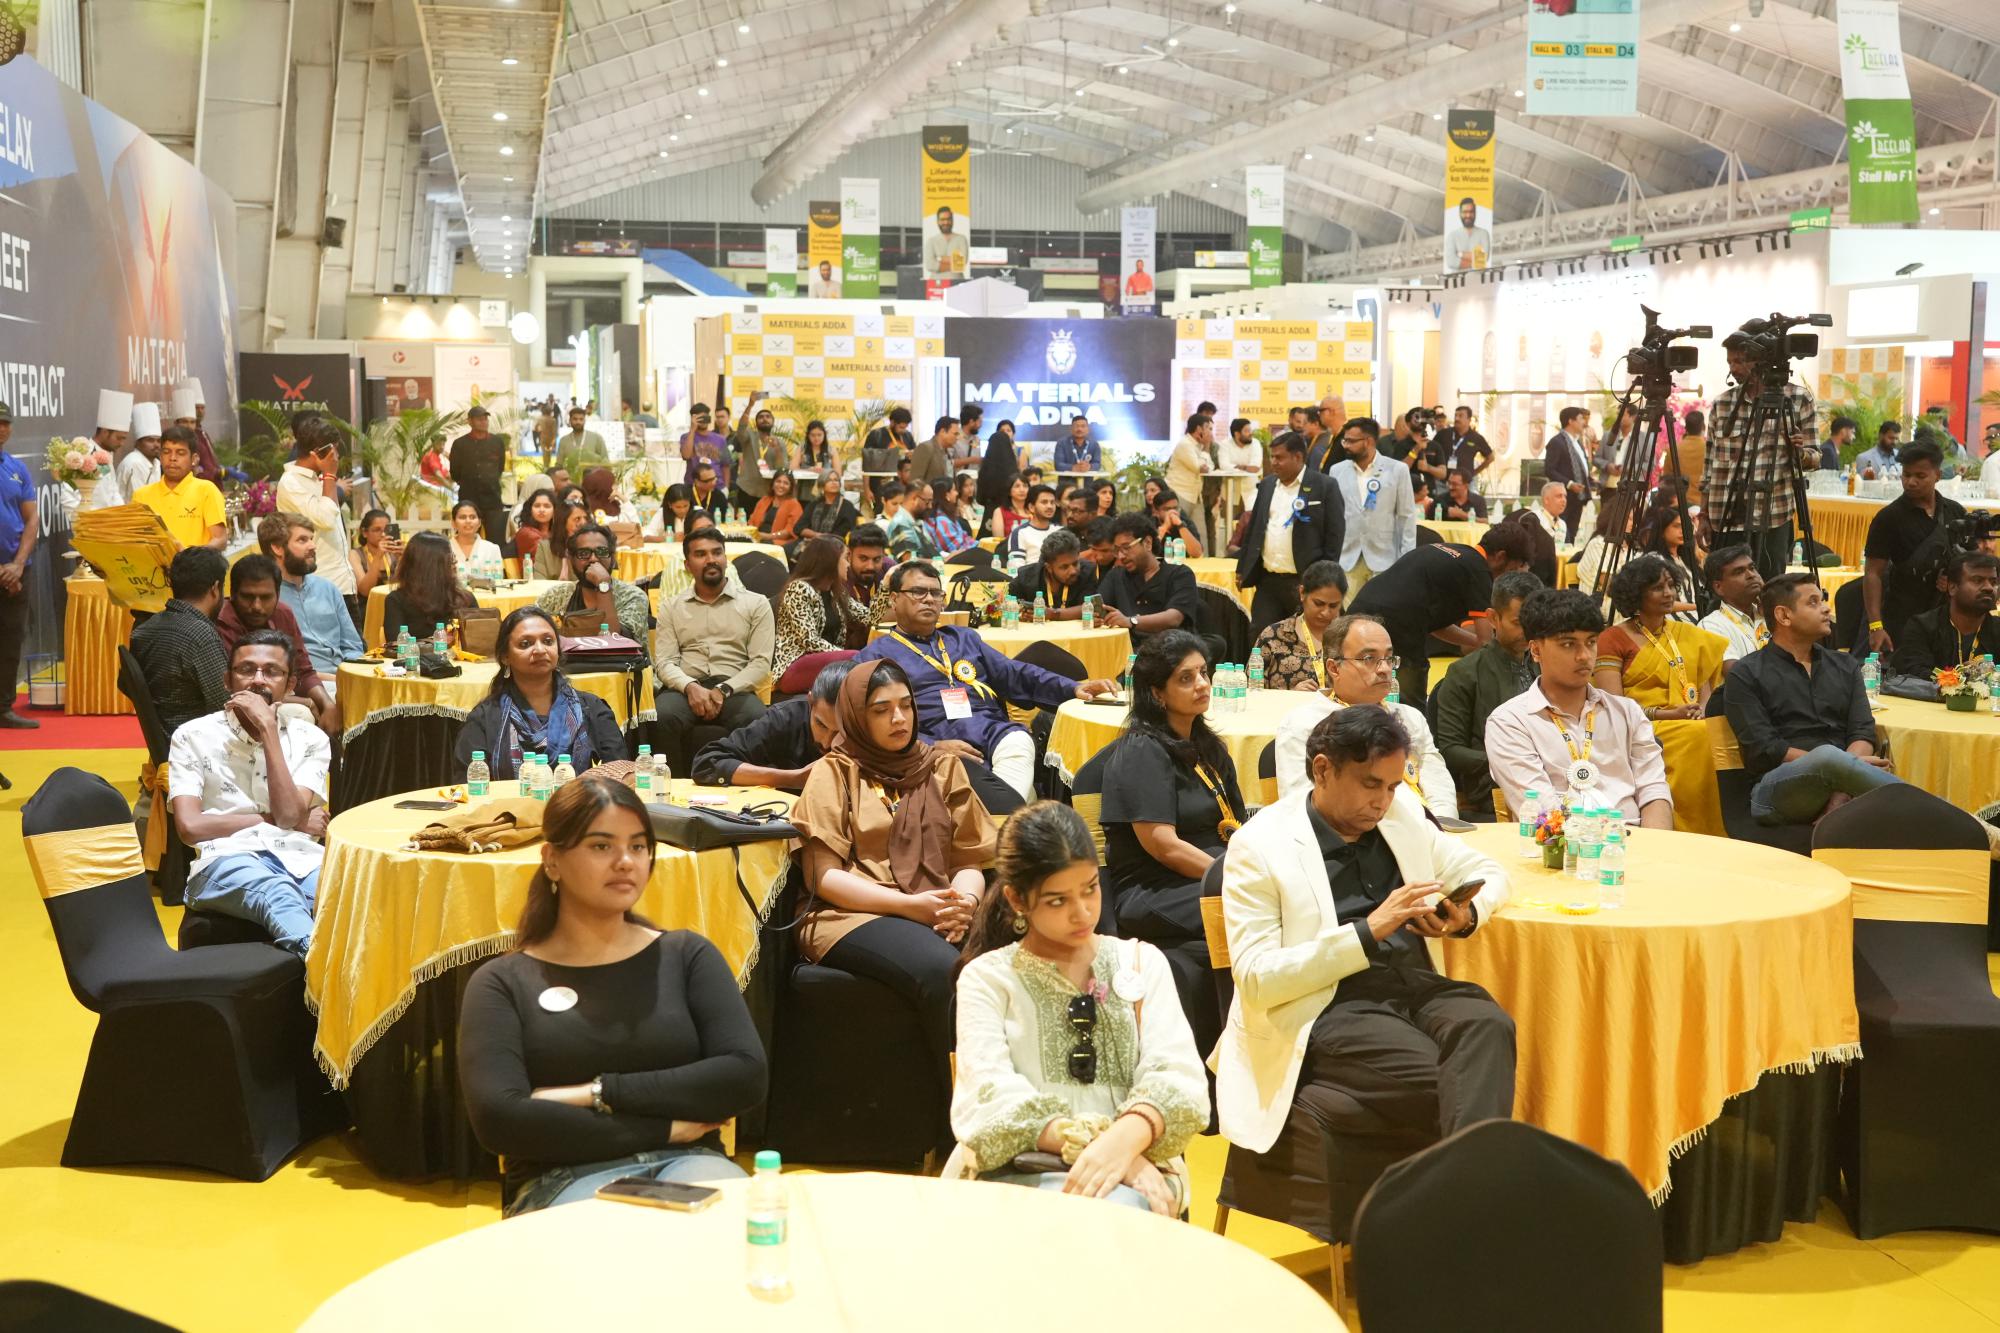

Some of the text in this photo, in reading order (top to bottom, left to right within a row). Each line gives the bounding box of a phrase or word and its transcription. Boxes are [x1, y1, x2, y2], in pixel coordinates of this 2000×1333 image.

[1566, 44, 1580, 56] 03
[1618, 45, 1635, 57] D4
[1454, 156, 1486, 164] Lifetime
[1449, 165, 1491, 173] Guarantee
[1858, 170, 1882, 183] Stall
[1883, 170, 1898, 182] No
[0, 231, 30, 293] EET
[769, 320, 847, 329] MATERIALS ADDA
[1240, 326, 1310, 335] MATERIALS ADDA
[128, 334, 188, 386] MATECIA
[831, 363, 907, 372] MATERIALS ADDA
[1295, 367, 1341, 375] MATERIALS
[964, 382, 1157, 403] MATERIALS
[823, 405, 847, 413] ADDA
[1239, 407, 1284, 415] MATERIALS
[1014, 405, 1107, 426] ADDA
